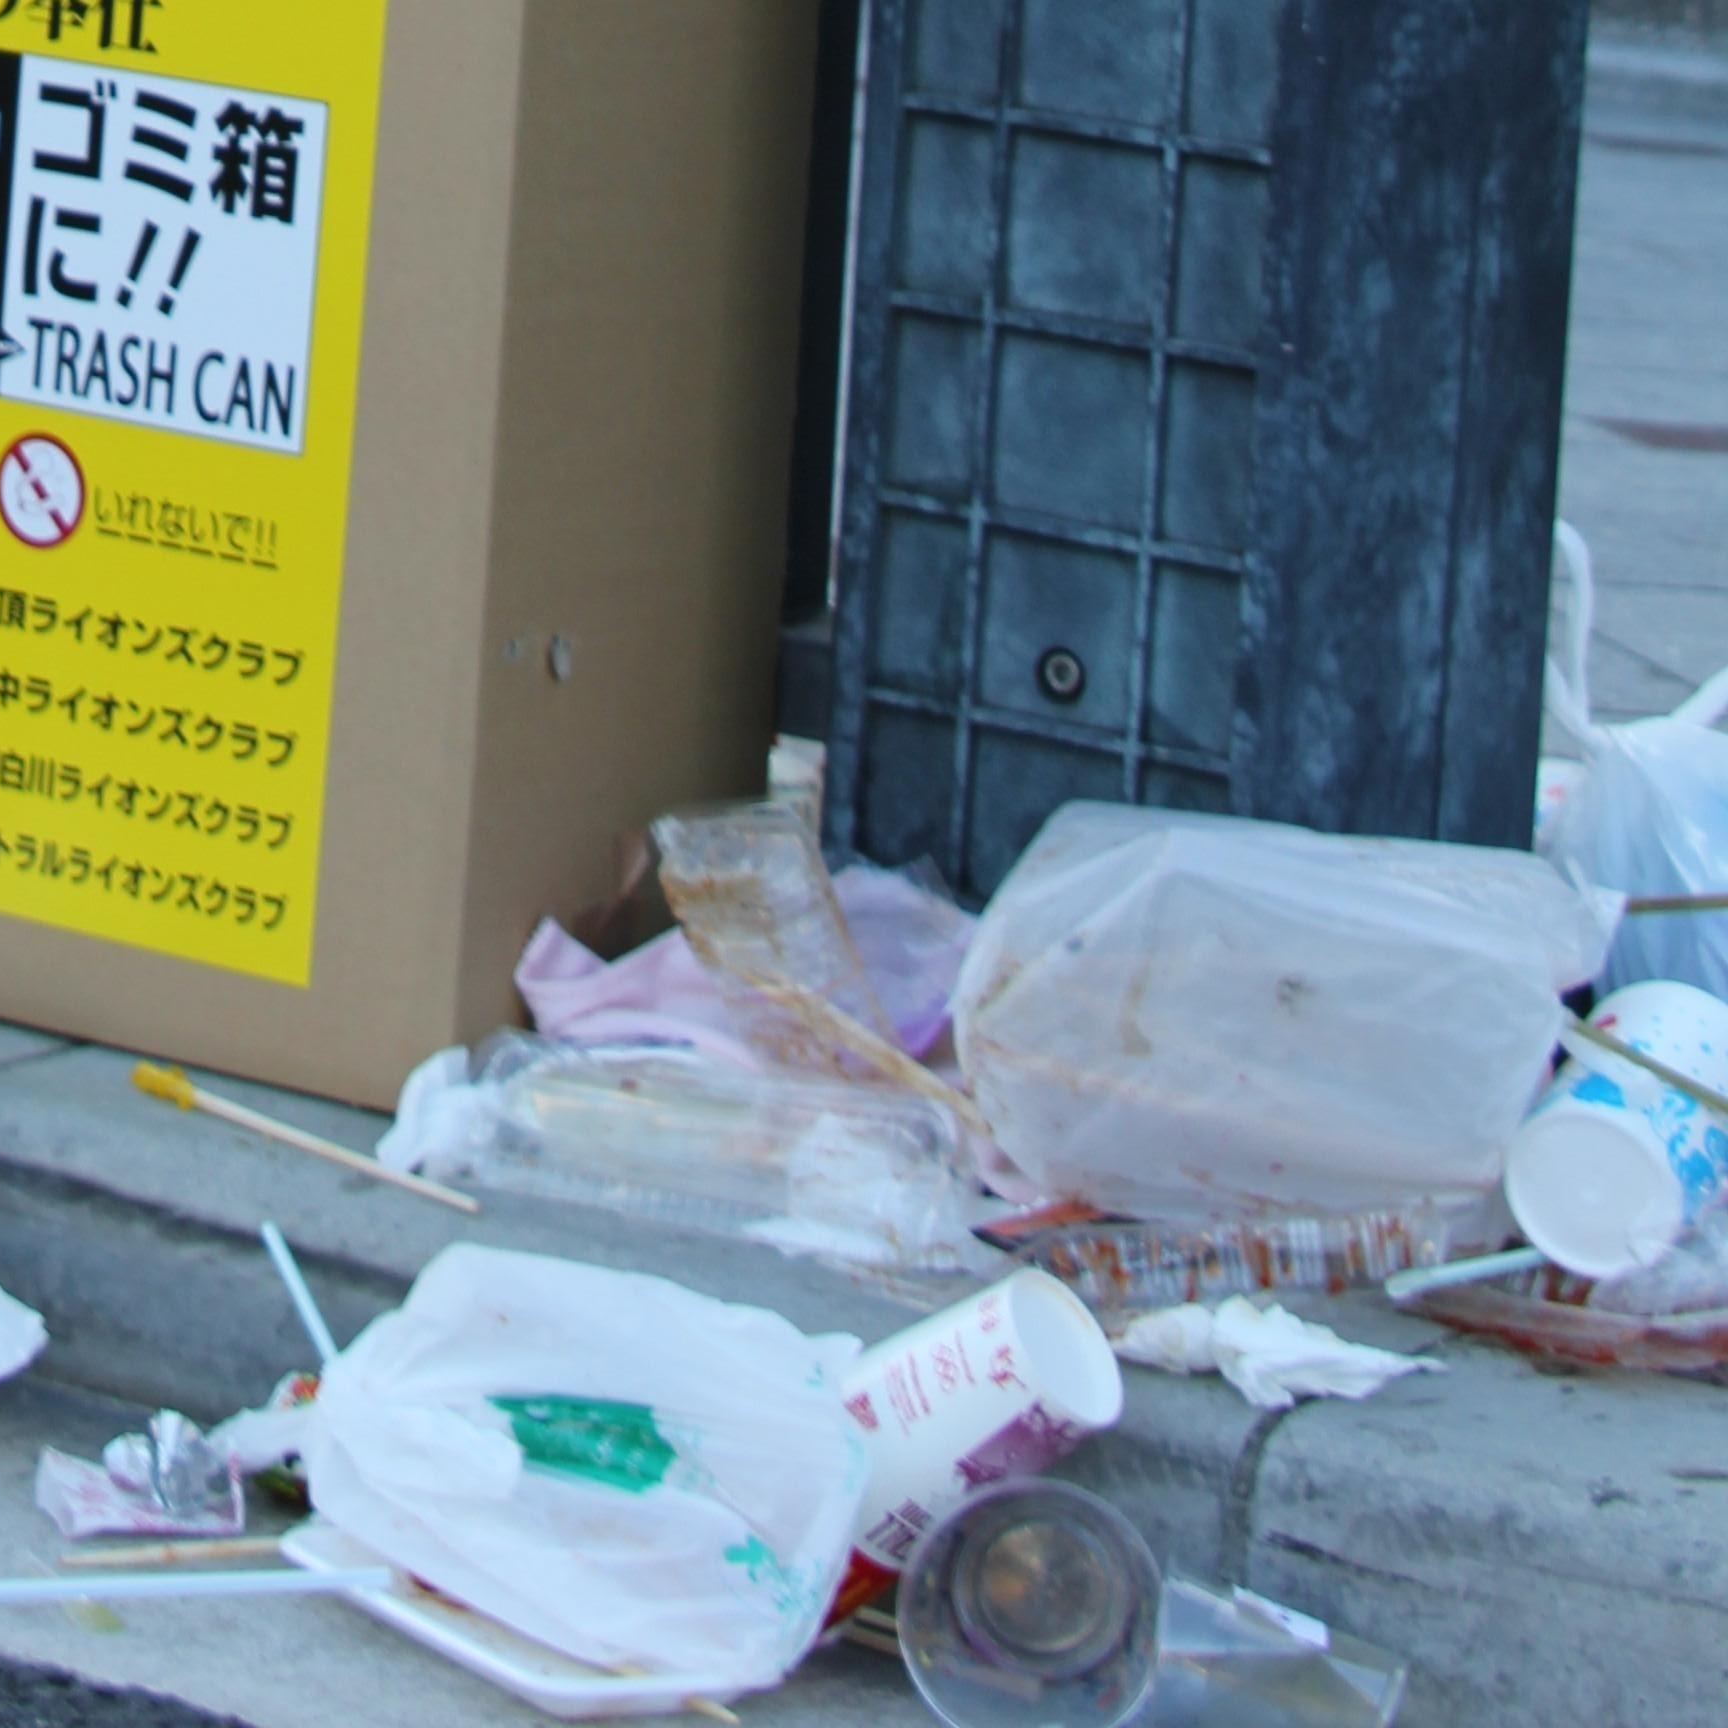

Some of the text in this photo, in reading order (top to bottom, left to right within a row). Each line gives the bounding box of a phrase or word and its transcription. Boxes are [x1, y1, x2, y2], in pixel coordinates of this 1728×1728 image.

[32, 79, 304, 225] ゴミ箱
[28, 317, 295, 437] TRASH CAN
